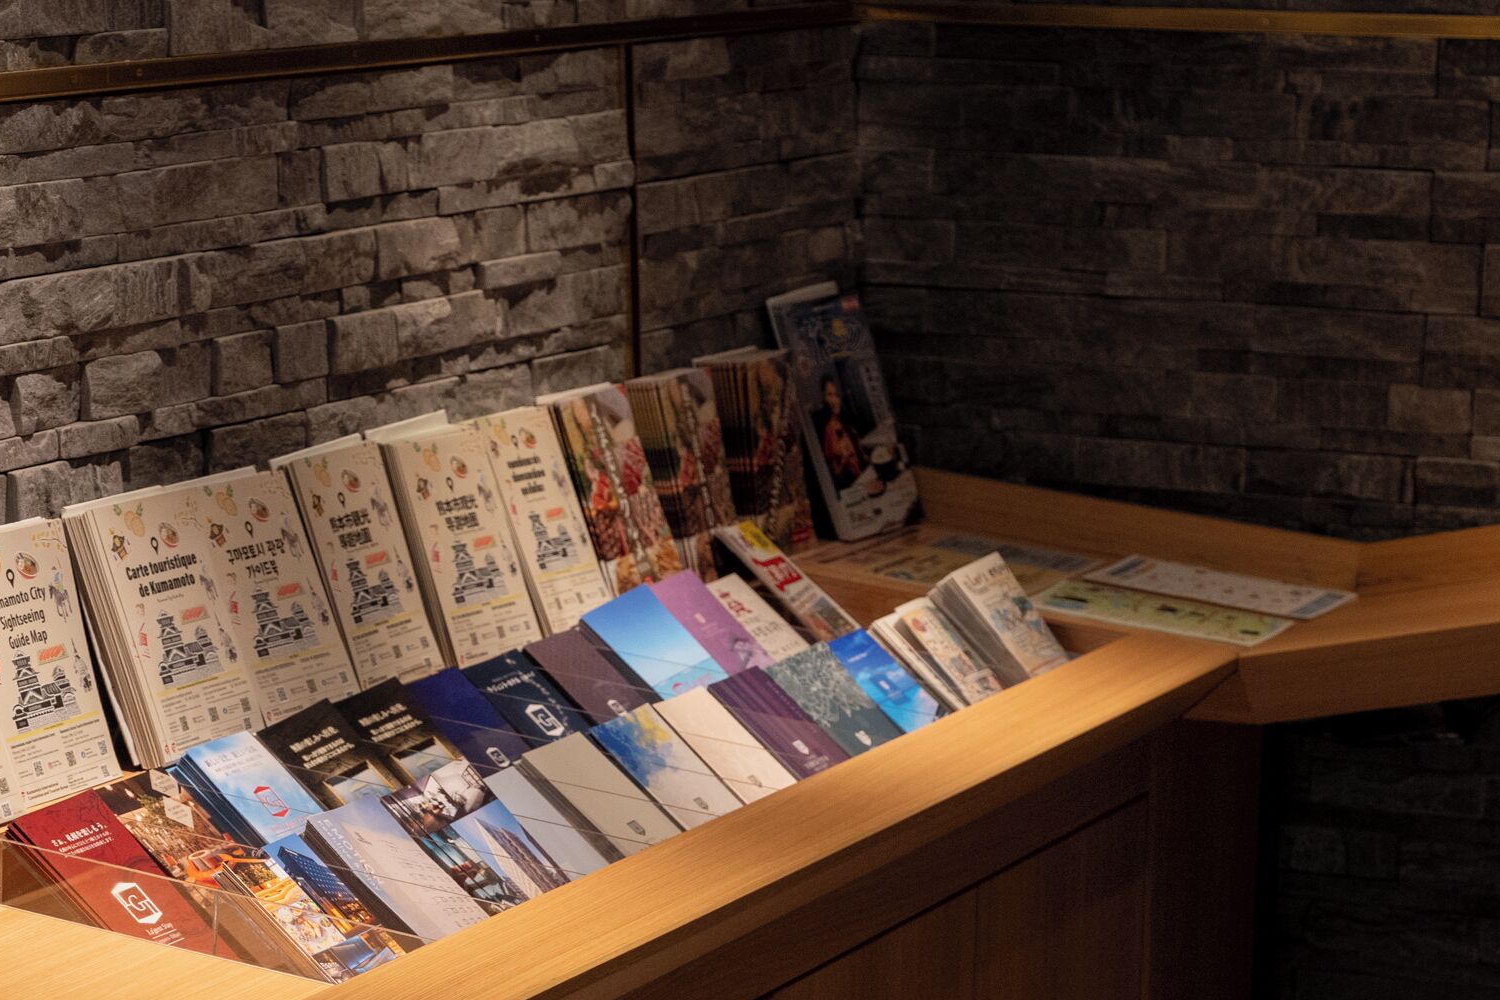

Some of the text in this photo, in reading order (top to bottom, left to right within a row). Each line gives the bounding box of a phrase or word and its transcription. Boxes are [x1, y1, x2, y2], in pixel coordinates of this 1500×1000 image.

[226, 543, 265, 565] 구마모토시
[126, 553, 197, 581] Carte touristique
[30, 586, 46, 601] City
[138, 583, 150, 598] de
[149, 573, 196, 595] Kumamoto
[0, 609, 45, 631] Sightseeing
[9, 630, 48, 649] Guide Map
